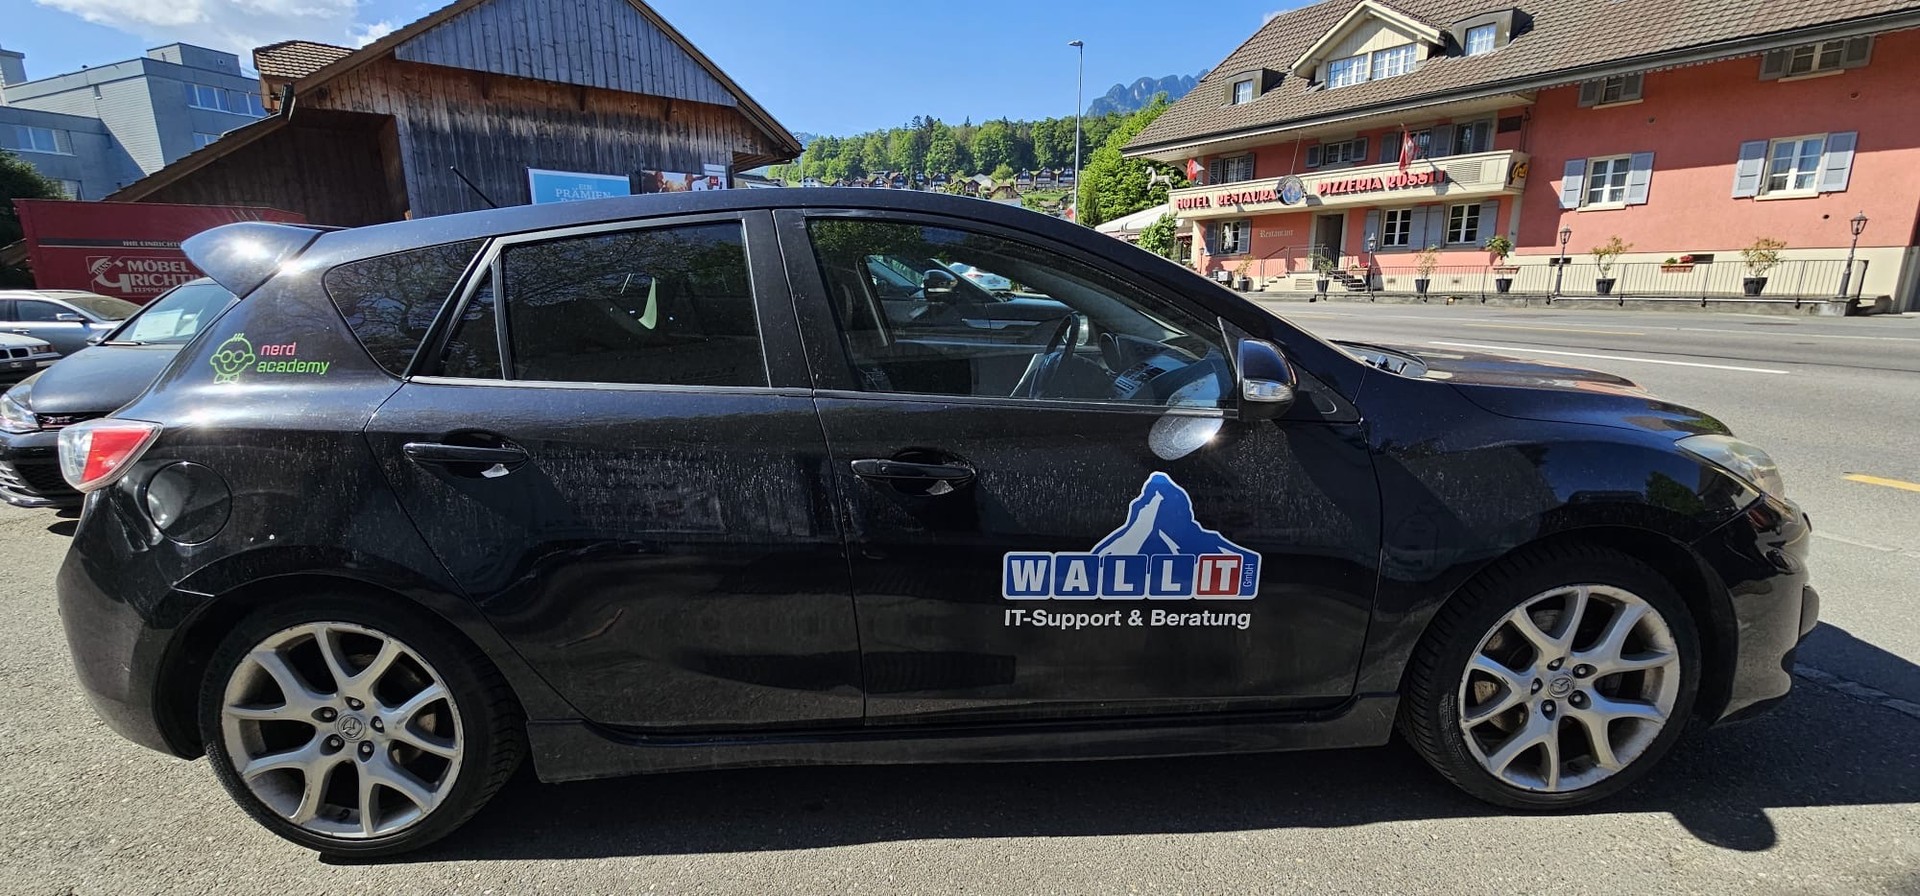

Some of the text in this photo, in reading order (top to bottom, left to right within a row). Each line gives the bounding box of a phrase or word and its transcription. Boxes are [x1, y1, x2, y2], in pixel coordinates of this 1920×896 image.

[1176, 196, 1208, 209] HOTEL
[1216, 189, 1277, 206] RESTAURA
[1317, 177, 1382, 194] PIZZERIA
[127, 259, 190, 273] MÖBEL
[261, 341, 297, 356] nerd
[256, 358, 330, 375] academy
[1242, 563, 1255, 589] GmbH
[1004, 609, 1251, 630] IT-Support & Beratung
